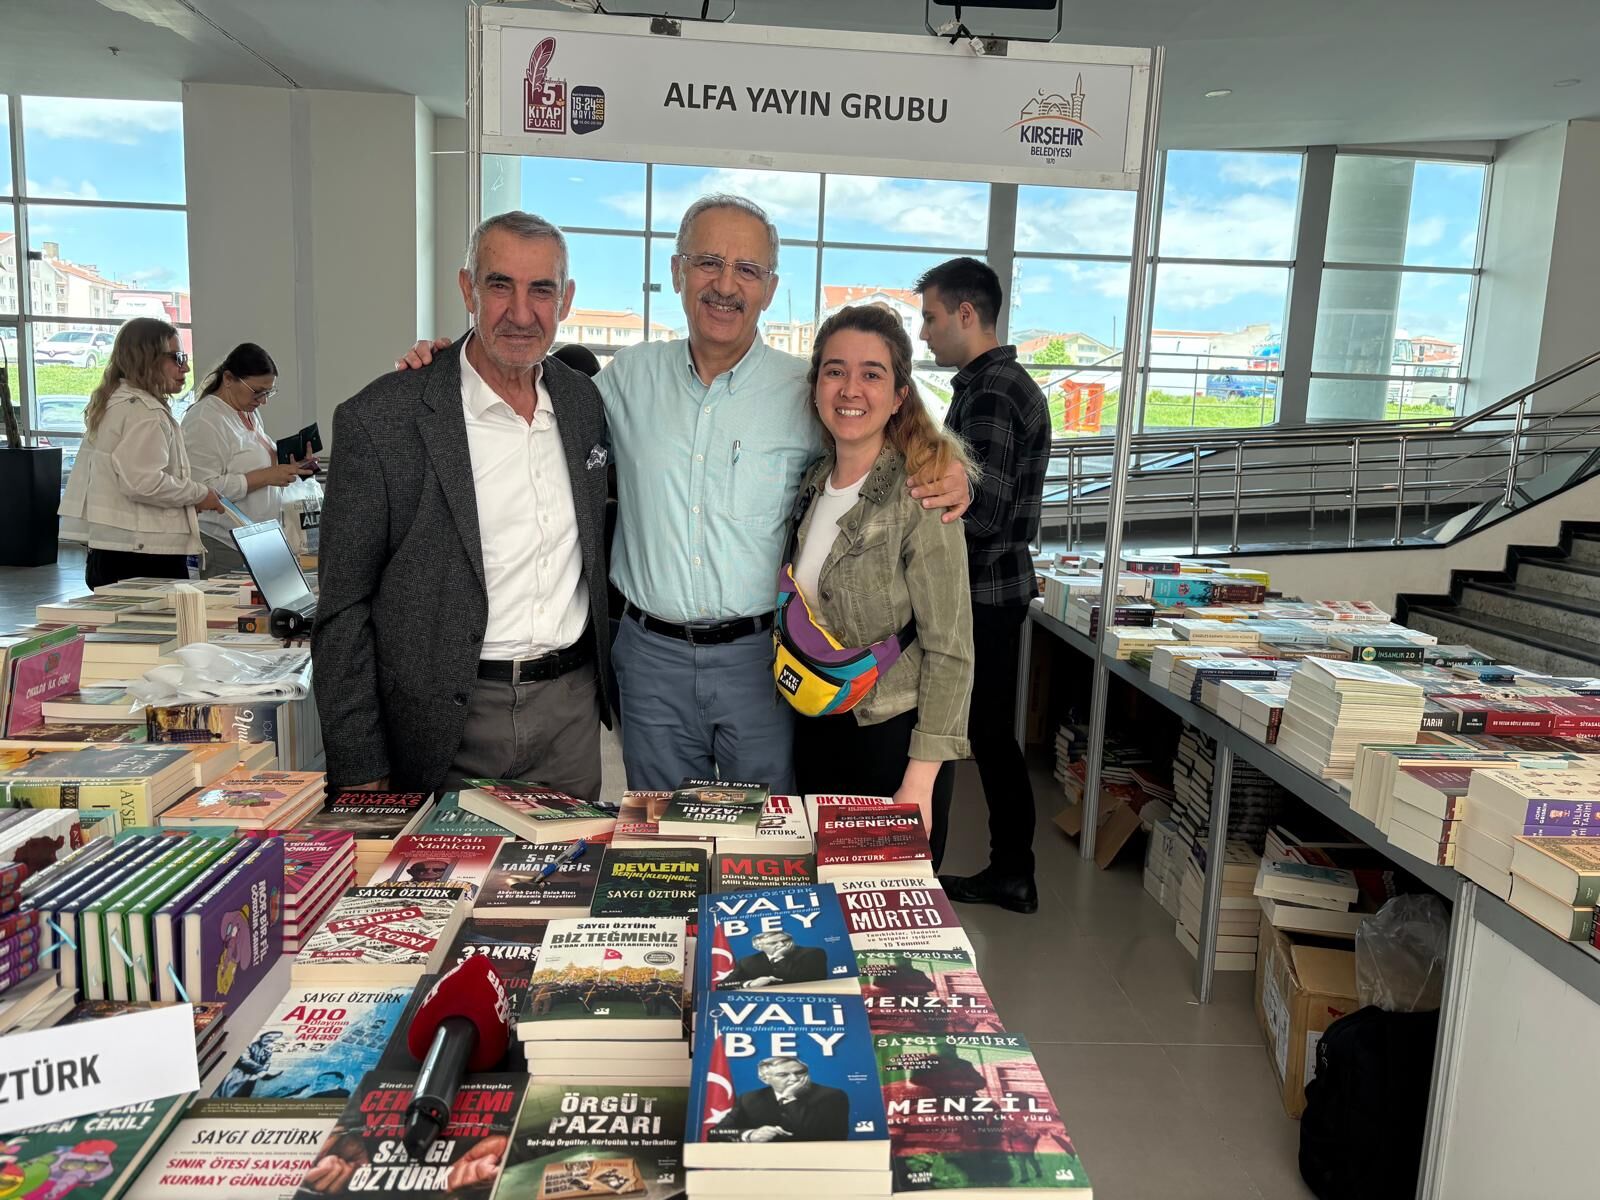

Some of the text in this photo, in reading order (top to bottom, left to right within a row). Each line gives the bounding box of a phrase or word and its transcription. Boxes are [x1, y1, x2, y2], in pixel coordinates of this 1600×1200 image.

[541, 82, 556, 105] 5
[571, 96, 596, 111] 15-24
[663, 82, 950, 124] ALFA YAYIN GRUBU
[572, 110, 596, 120] MAYIS
[528, 119, 561, 129] FUARI
[1405, 650, 1416, 660] 2.0
[335, 799, 421, 807] KUMPAS
[365, 806, 409, 814] ÖZTÜRK
[682, 806, 744, 816] PAZARI
[824, 817, 919, 829] ERGENEKON
[409, 835, 483, 843] Madalyalı
[851, 854, 885, 862] ÖZTÜRK
[612, 861, 700, 873] DEVLETİN
[721, 857, 809, 876] MGK
[761, 875, 811, 883] Bugünüyle
[842, 878, 927, 890] SAYGI ÖZTÜRK
[356, 887, 452, 898] SAYGI ÖZTÜRK
[607, 888, 697, 899] SAYGI ÖZTÜRK
[722, 891, 761, 901] SAYGI
[845, 890, 936, 910] KOD ADI
[251, 884, 259, 930] GÖRDÜM
[258, 880, 269, 962] MOR BİR FİL
[334, 909, 417, 930] KRİPTO
[612, 921, 657, 930] ÖZTÜRK
[723, 910, 821, 938] BEY
[850, 908, 943, 931] MÜRTED
[365, 924, 431, 948] ÜÇGENİ
[551, 930, 678, 945] BİZ TEĞMENİZ
[896, 940, 931, 948] Temmuz
[856, 951, 964, 960] AYGI ÖZTÜRK
[300, 991, 405, 1004] SAYGI ÖZTÜRK
[727, 994, 838, 1004] SAYGI ÖZTÜRK
[281, 1005, 348, 1025] Apo
[294, 1024, 344, 1034] Perde
[745, 1025, 787, 1033] ağladım
[810, 1025, 846, 1033] yazdım
[295, 1032, 340, 1041] Arkası
[877, 1035, 1020, 1048] SAYGI ÖZTÜRK
[724, 1032, 846, 1058] BEY
[560, 1092, 658, 1114] ÖRGÜT
[887, 1093, 1049, 1116] MENZİL
[84, 1115, 152, 1135] ÇEKİL!
[549, 1115, 662, 1135] PAZARI
[917, 1114, 985, 1123] tarikatın
[1022, 1114, 1053, 1123] yüzü
[192, 1127, 323, 1146] SAYGI ÖZTÜRK
[373, 1140, 457, 1164] SAGI
[166, 1157, 208, 1170] SINIR
[210, 1155, 252, 1170] ÖTESİ
[159, 1170, 304, 1187] KURMAY GÜNLÜĞÜ
[348, 1163, 456, 1192] ÖZTÜRK
